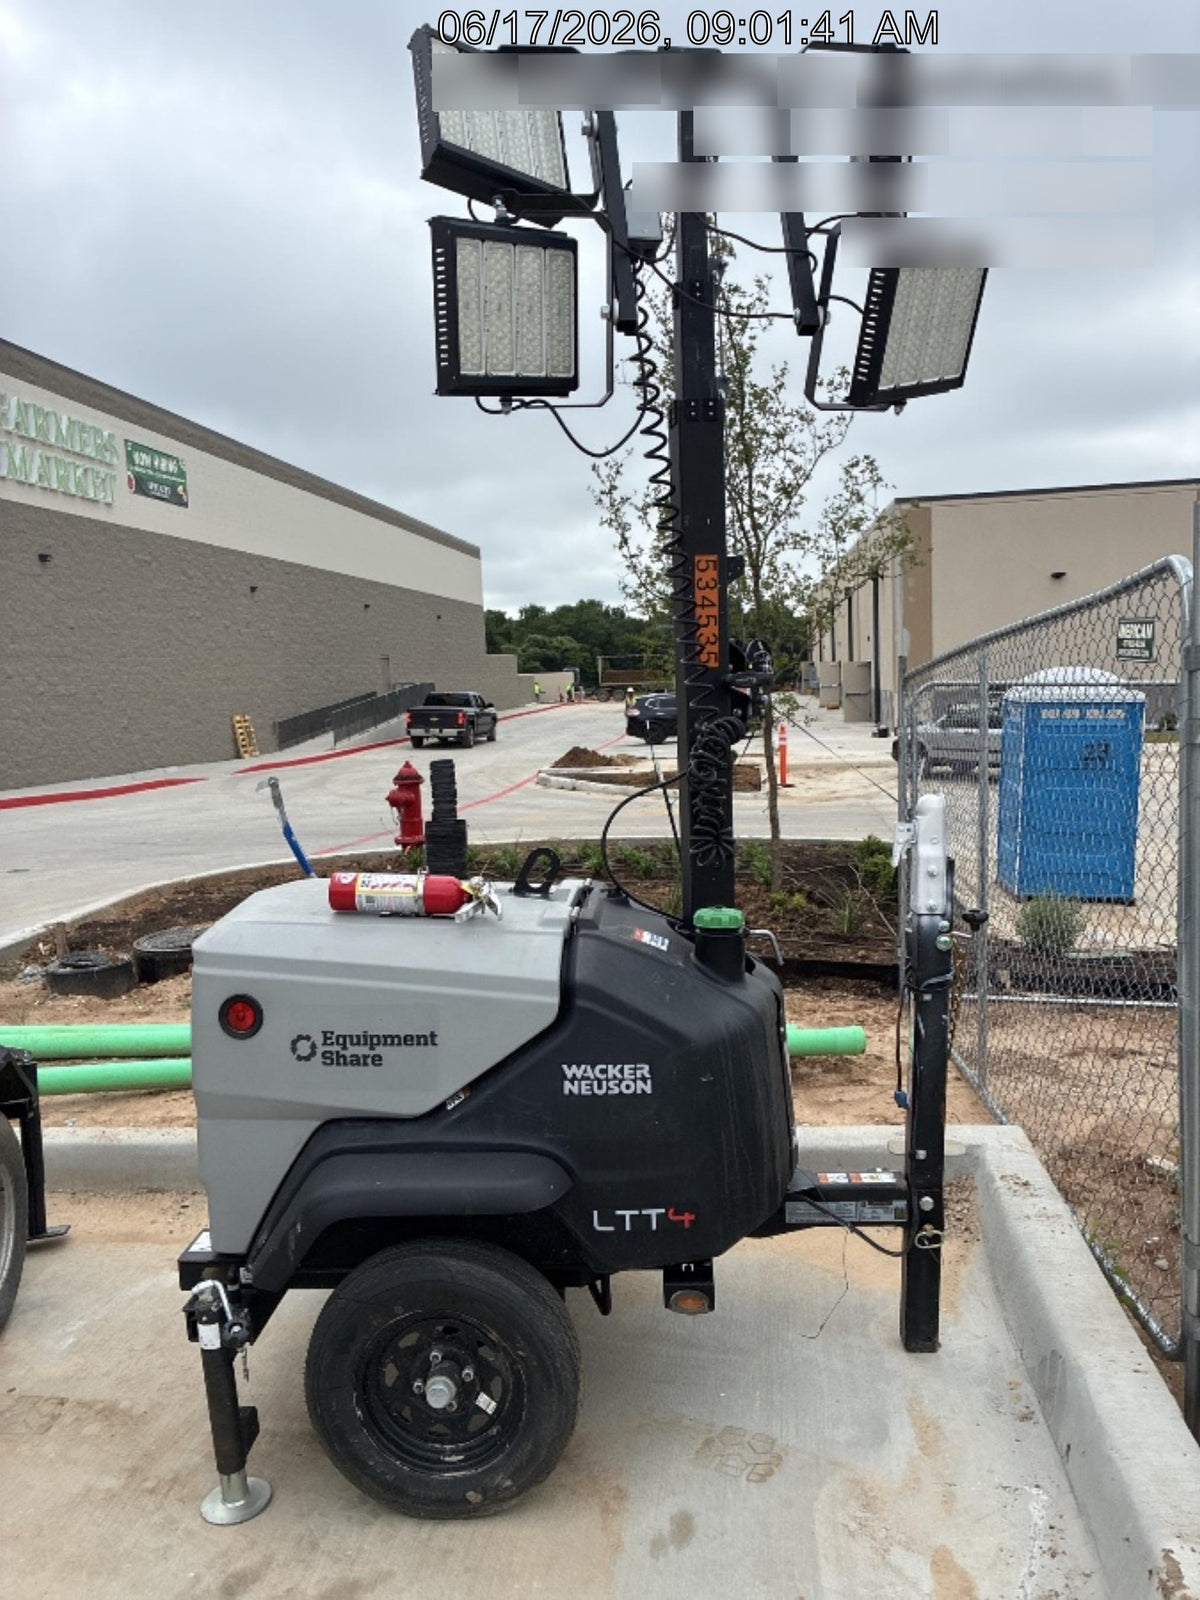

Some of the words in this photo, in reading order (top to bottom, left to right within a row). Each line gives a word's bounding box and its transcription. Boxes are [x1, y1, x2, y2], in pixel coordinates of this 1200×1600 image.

[0, 439, 116, 505] MARKET
[321, 1031, 438, 1050] Equipment
[321, 1050, 383, 1067] Share
[561, 1063, 652, 1080] WACKER
[563, 1080, 653, 1096] NEUSON
